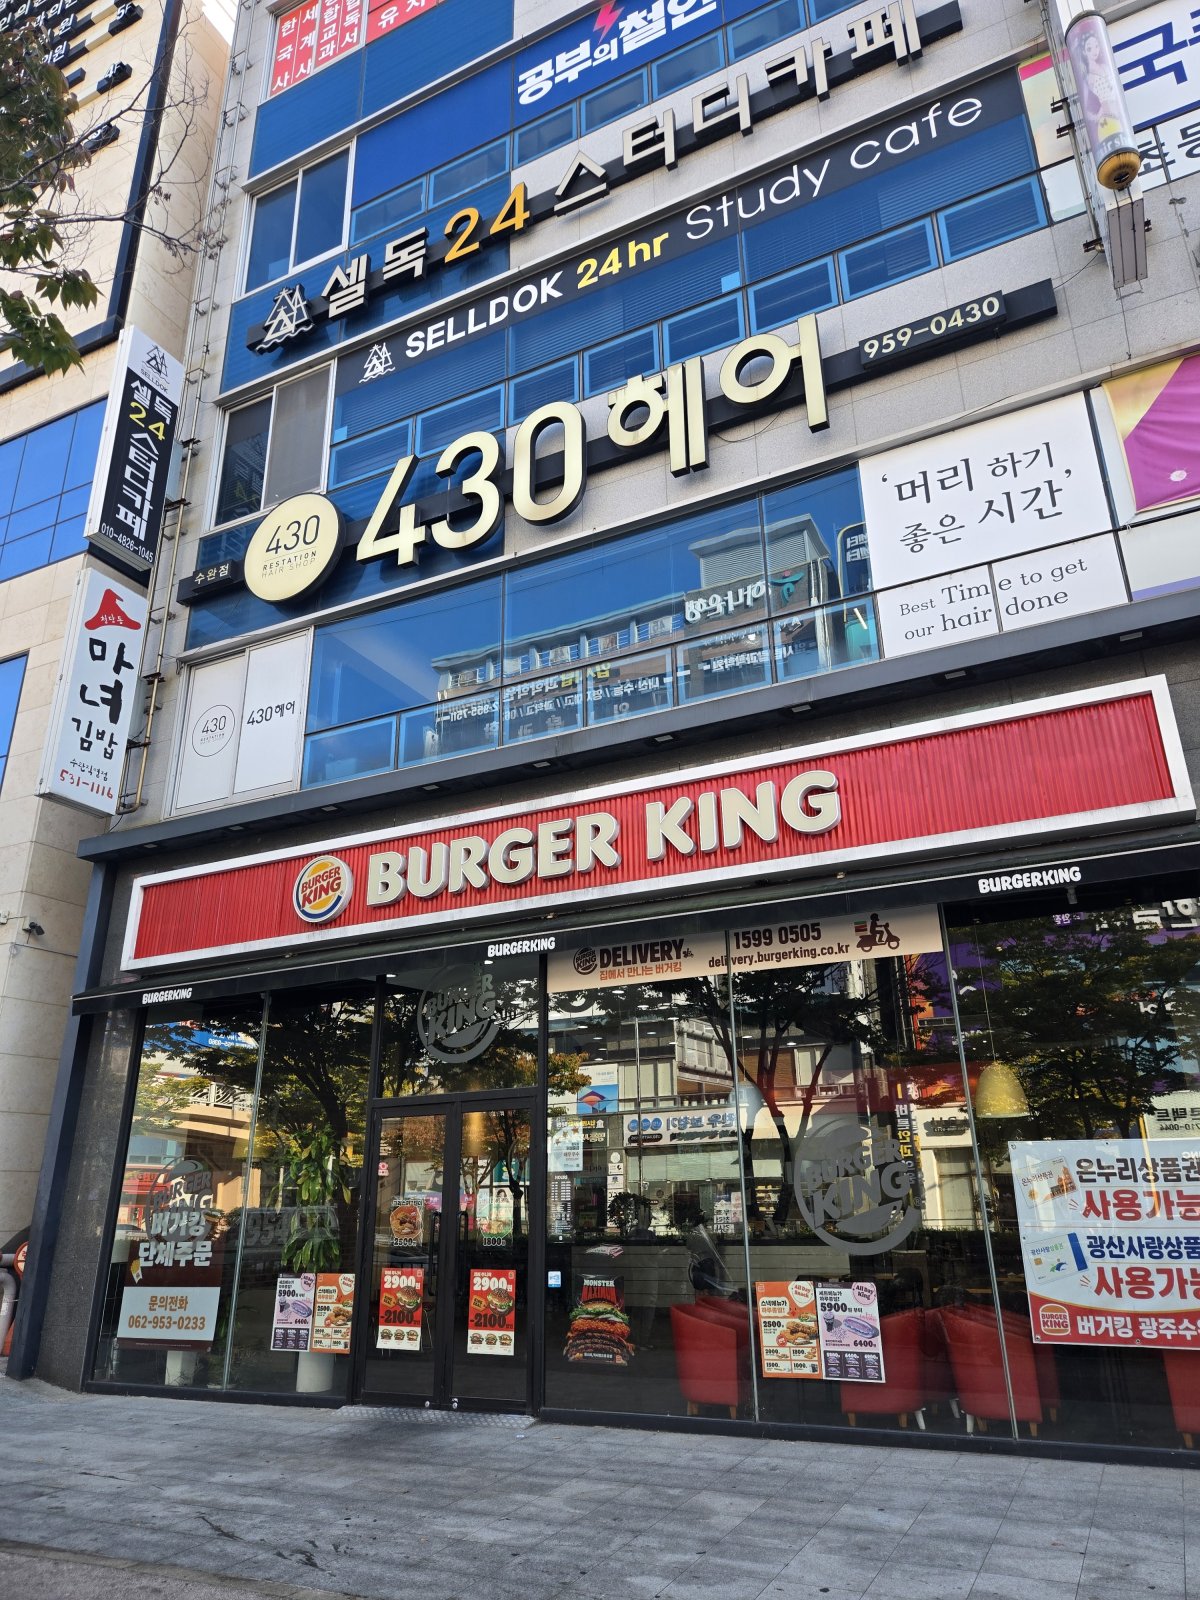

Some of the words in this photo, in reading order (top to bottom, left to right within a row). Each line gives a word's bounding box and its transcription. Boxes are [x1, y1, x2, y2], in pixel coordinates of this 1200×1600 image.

[272, 17, 298, 92] 한국사
[553, 0, 923, 217] 스터디카페
[404, 271, 564, 359] SELLDOK
[576, 232, 669, 290] 24hr
[685, 158, 830, 240] Study
[849, 97, 983, 170] cafe
[862, 296, 1002, 360] 959-0430
[140, 367, 169, 394] SELLDOK
[986, 441, 1055, 480] 하기
[115, 432, 160, 542] 스터디카페
[101, 522, 154, 564] 010-4826-1045
[265, 514, 321, 555] 430
[899, 513, 966, 554] 좋은
[194, 563, 230, 585] 수완점
[262, 550, 317, 572] RESTATION
[899, 598, 937, 617] Best
[941, 576, 1012, 606] Time
[1020, 569, 1043, 587] to
[1050, 557, 1088, 583] get
[904, 624, 935, 641] our
[940, 605, 993, 633] hair
[1004, 590, 1069, 618] done
[71, 716, 119, 760] 김밥
[201, 715, 227, 734] 430
[59, 769, 113, 799] 531-1116
[366, 812, 621, 908] BURGER
[645, 769, 841, 862] KING
[300, 866, 341, 895] BURGER
[301, 876, 342, 910] KING
[978, 866, 1082, 894] BURGERKING
[486, 936, 557, 958] BURGERKING
[733, 929, 773, 950] 1599
[778, 922, 822, 944] 0505
[600, 939, 685, 969] DELIVERY
[708, 942, 850, 968] delivery.burgerking.co.kr
[599, 968, 625, 981] 집에서
[627, 965, 653, 978] 만나는
[655, 961, 682, 974] 버거킹
[142, 987, 193, 1005] BURGERKING
[811, 1160, 912, 1229] KING
[150, 1210, 206, 1237] 버거킹
[138, 1239, 213, 1267] 단체주문
[1086, 1234, 1200, 1260] 광산사랑상품
[583, 1278, 615, 1287] MONSTER
[149, 1295, 189, 1311] 문의전화
[1041, 1312, 1068, 1321] BURGER
[128, 1315, 206, 1331] 062-953-0233
[1042, 1319, 1069, 1329] KING
[1077, 1315, 1132, 1338] 버거킹
